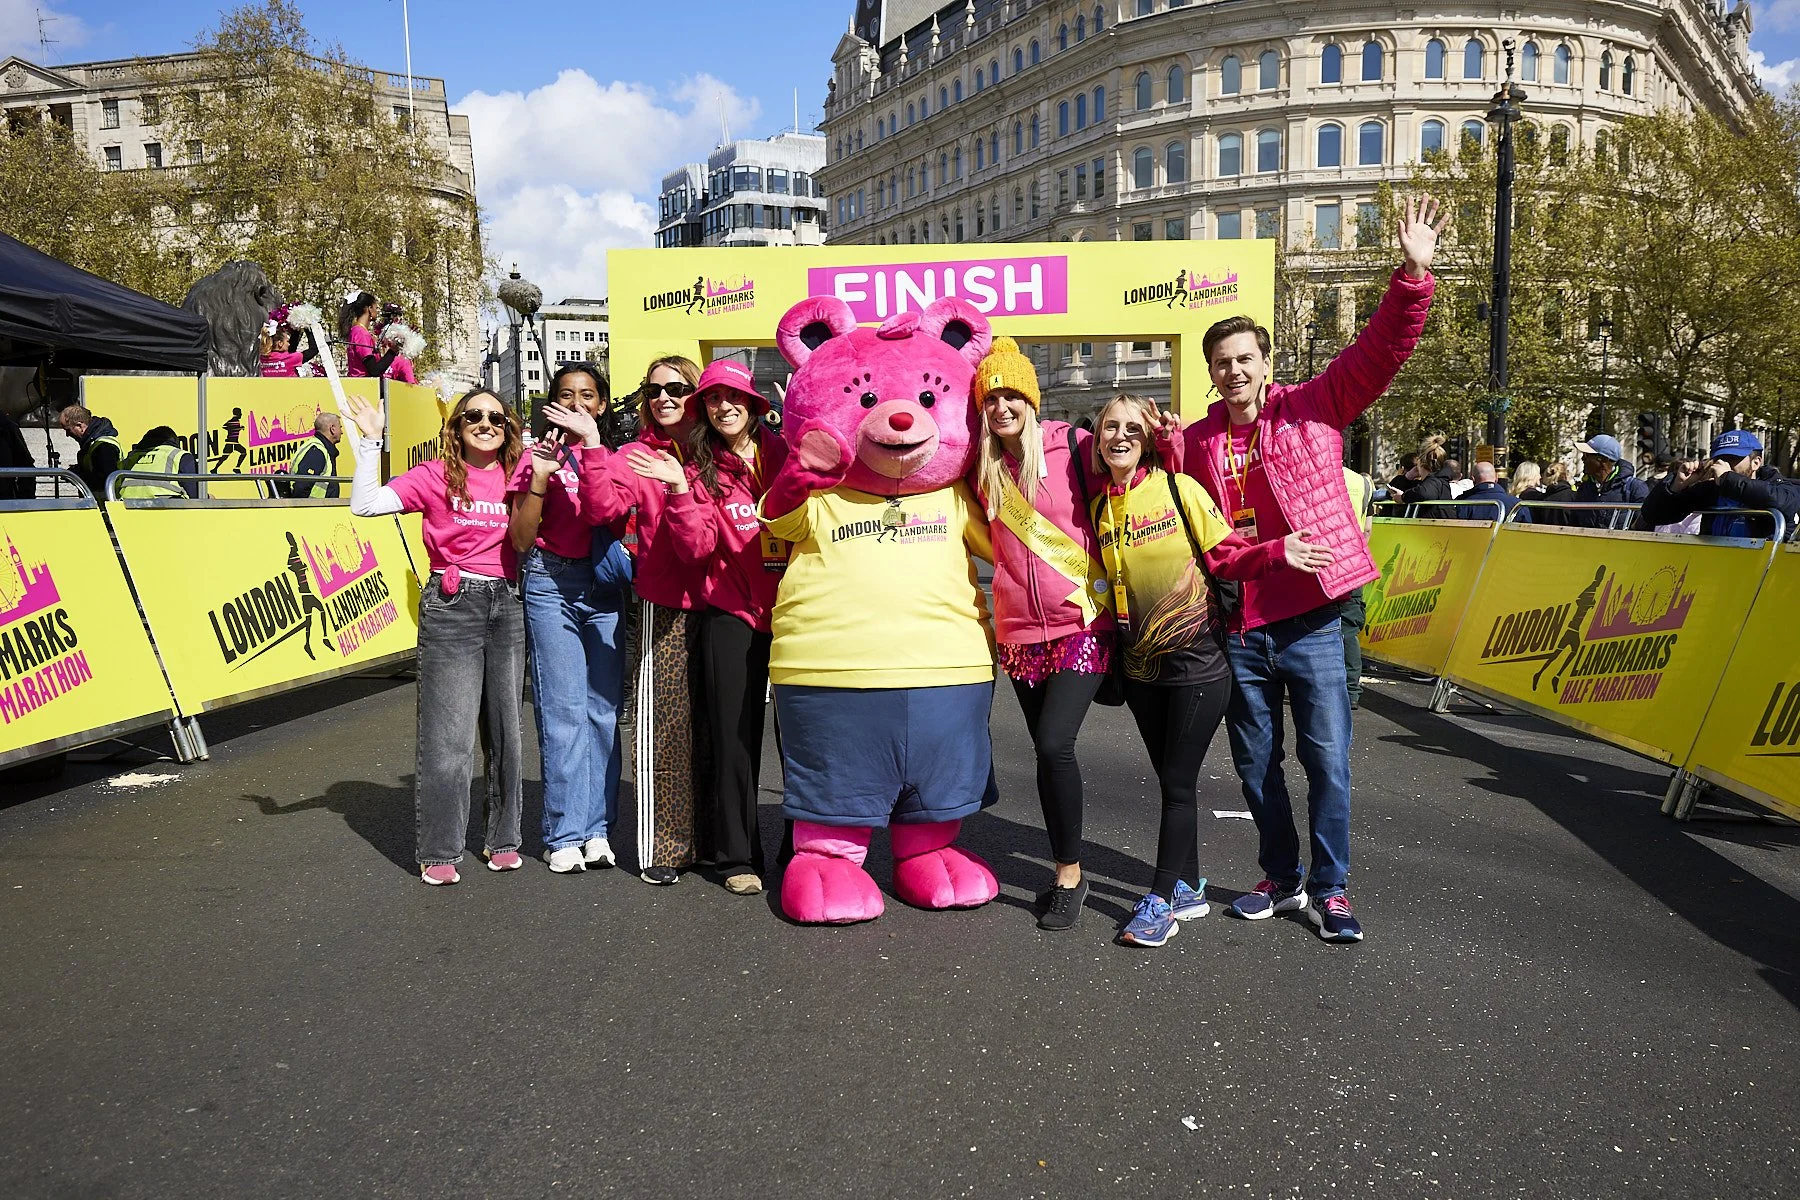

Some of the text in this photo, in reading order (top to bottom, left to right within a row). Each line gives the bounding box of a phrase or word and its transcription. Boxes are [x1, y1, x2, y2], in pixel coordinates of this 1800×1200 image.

[644, 289, 691, 311] LONDON
[707, 290, 754, 308] LANDMARKS
[834, 263, 1044, 318] FINISH
[1124, 282, 1173, 305] LONDON
[1189, 284, 1238, 301] LANDMARKS
[707, 300, 755, 316] HALF MARATHON
[1188, 294, 1238, 310] HALF MARATHON
[452, 496, 507, 515] Tomm
[453, 516, 488, 528] Together,
[832, 520, 881, 542] LONDON
[900, 525, 947, 537] LANDMARKS
[1132, 518, 1177, 540] LANDMARKS
[900, 534, 947, 544] HALF MARATHON
[1147, 526, 1178, 543] MARATHON
[325, 570, 390, 632] LANDMARKS
[1377, 588, 1441, 623] LANDMARKS
[208, 572, 302, 664] LONDON
[337, 599, 400, 658] HALF MARATHON
[1369, 615, 1432, 643] HALF MARATHON
[1481, 602, 1571, 659] LONDON
[0, 608, 78, 681] MARKS
[1570, 633, 1678, 677] LANDMARKS
[0, 649, 93, 725] MARATHON
[1559, 672, 1664, 705] HALF MARATHON
